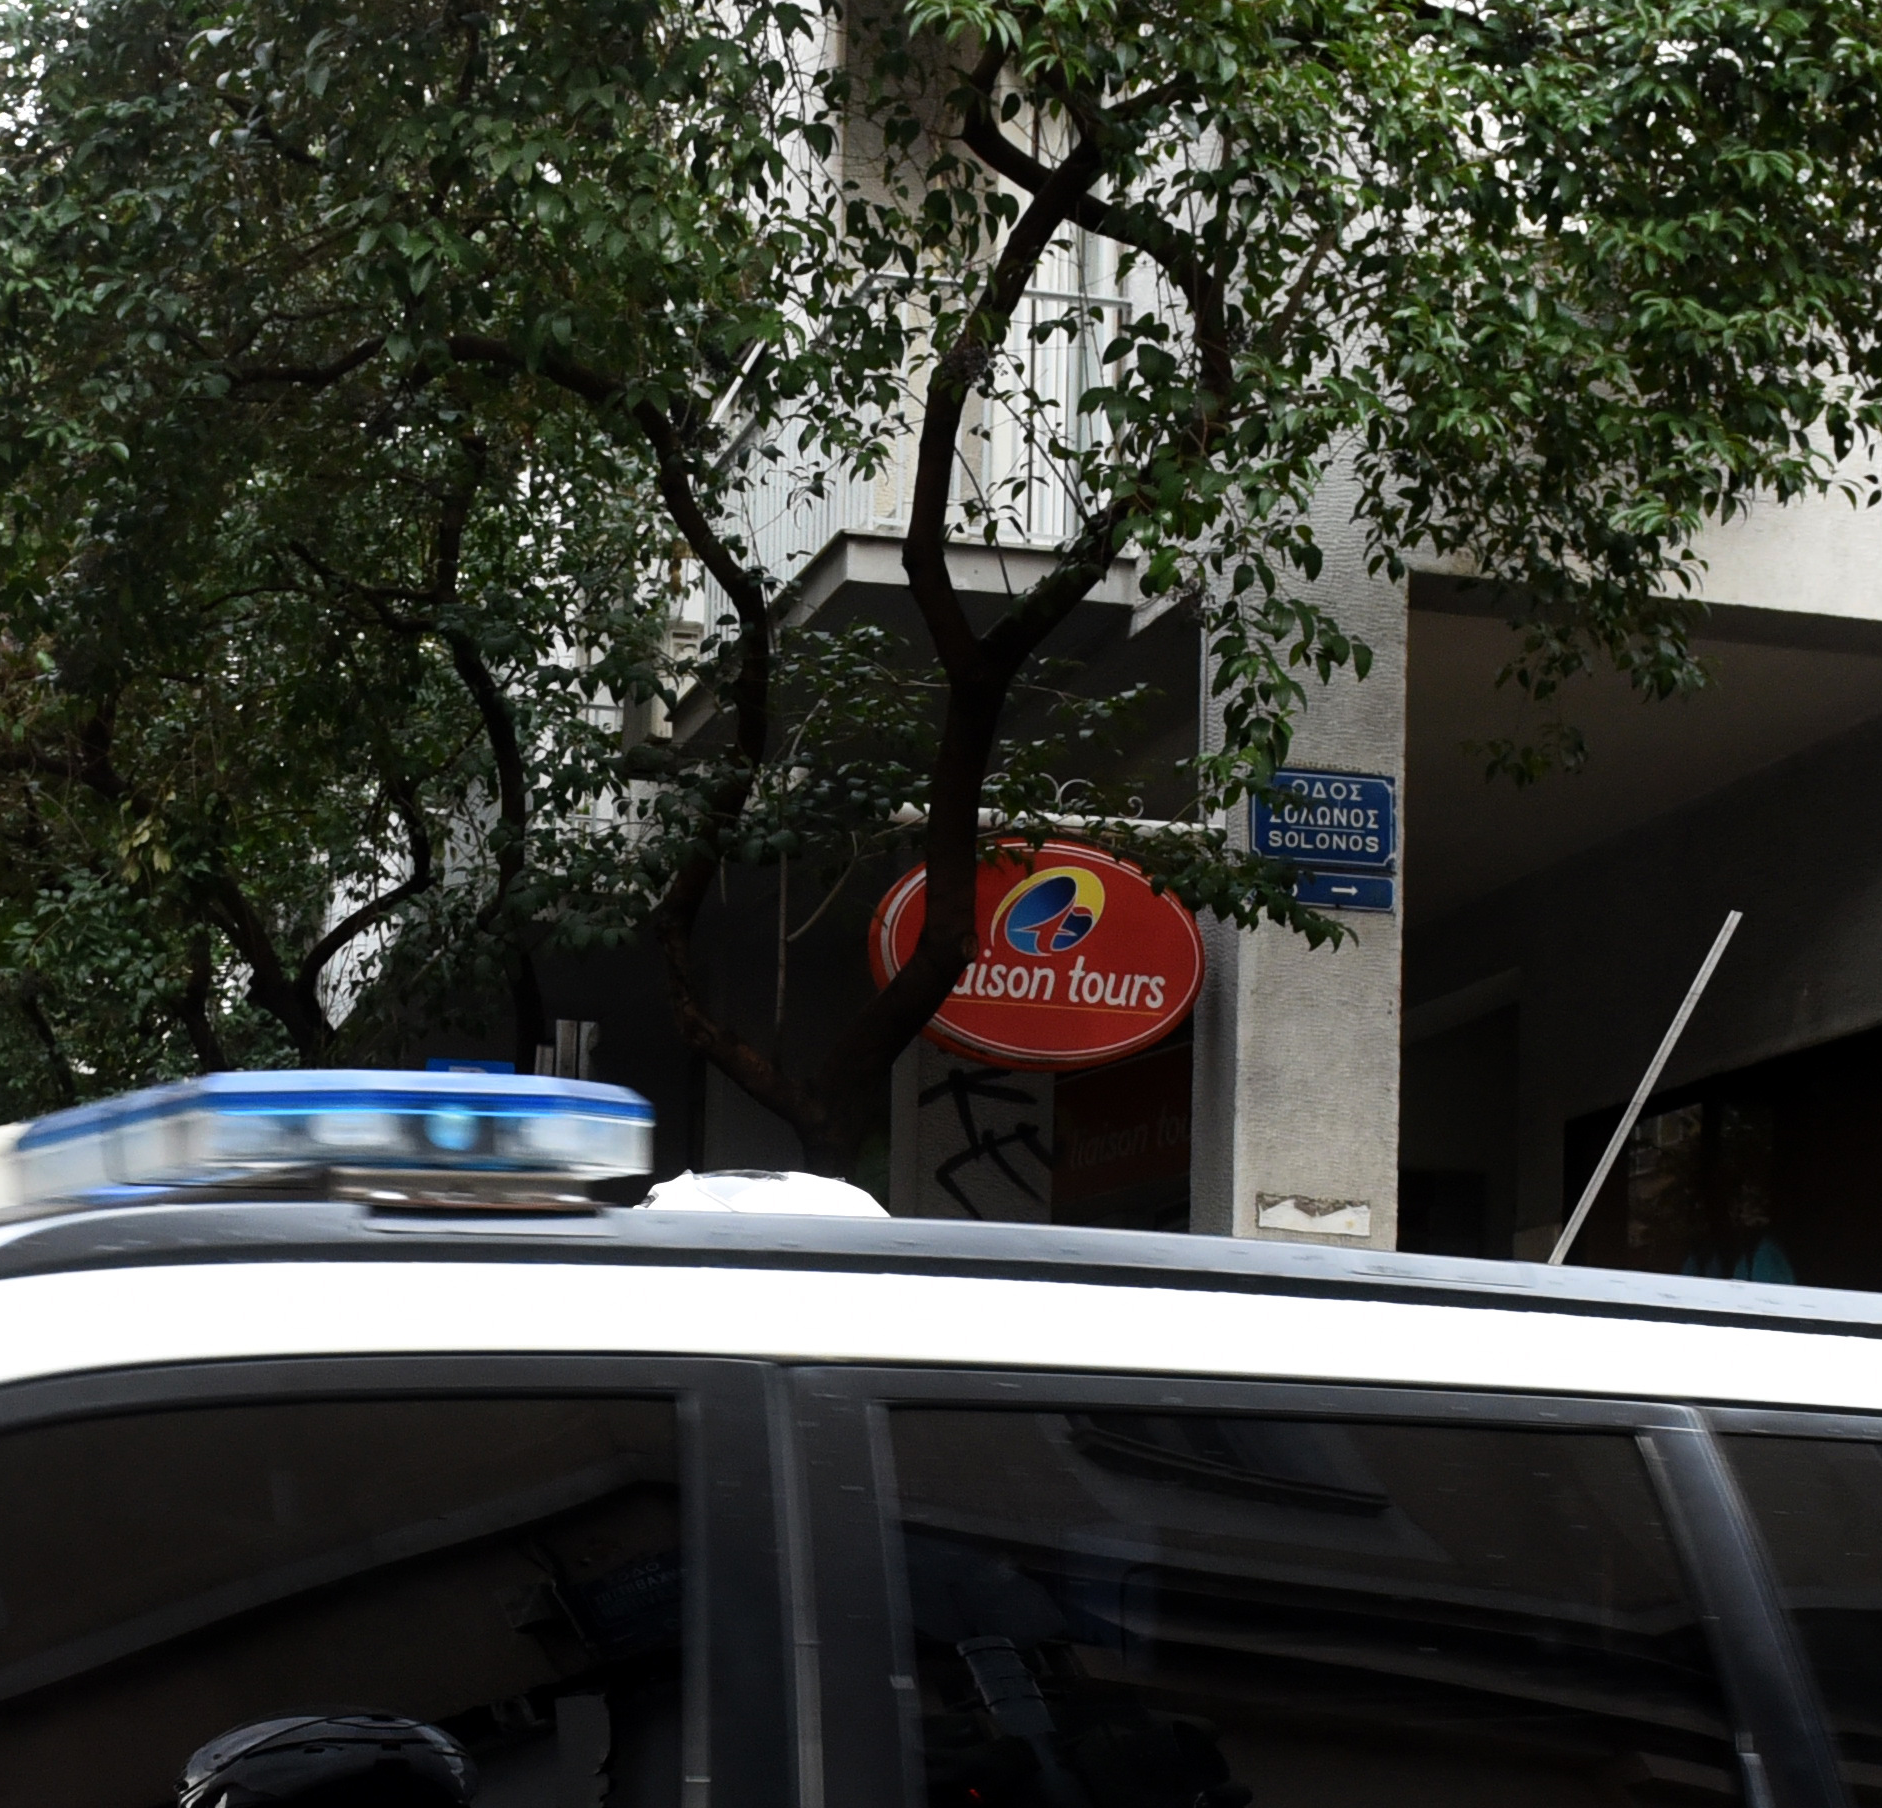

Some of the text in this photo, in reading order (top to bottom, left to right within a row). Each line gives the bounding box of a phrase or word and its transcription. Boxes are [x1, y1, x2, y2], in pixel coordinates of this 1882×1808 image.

[1291, 779, 1363, 801] ΟΔΟΣ
[1268, 830, 1380, 853] SOLONOS
[952, 948, 1166, 1009] aison tours
